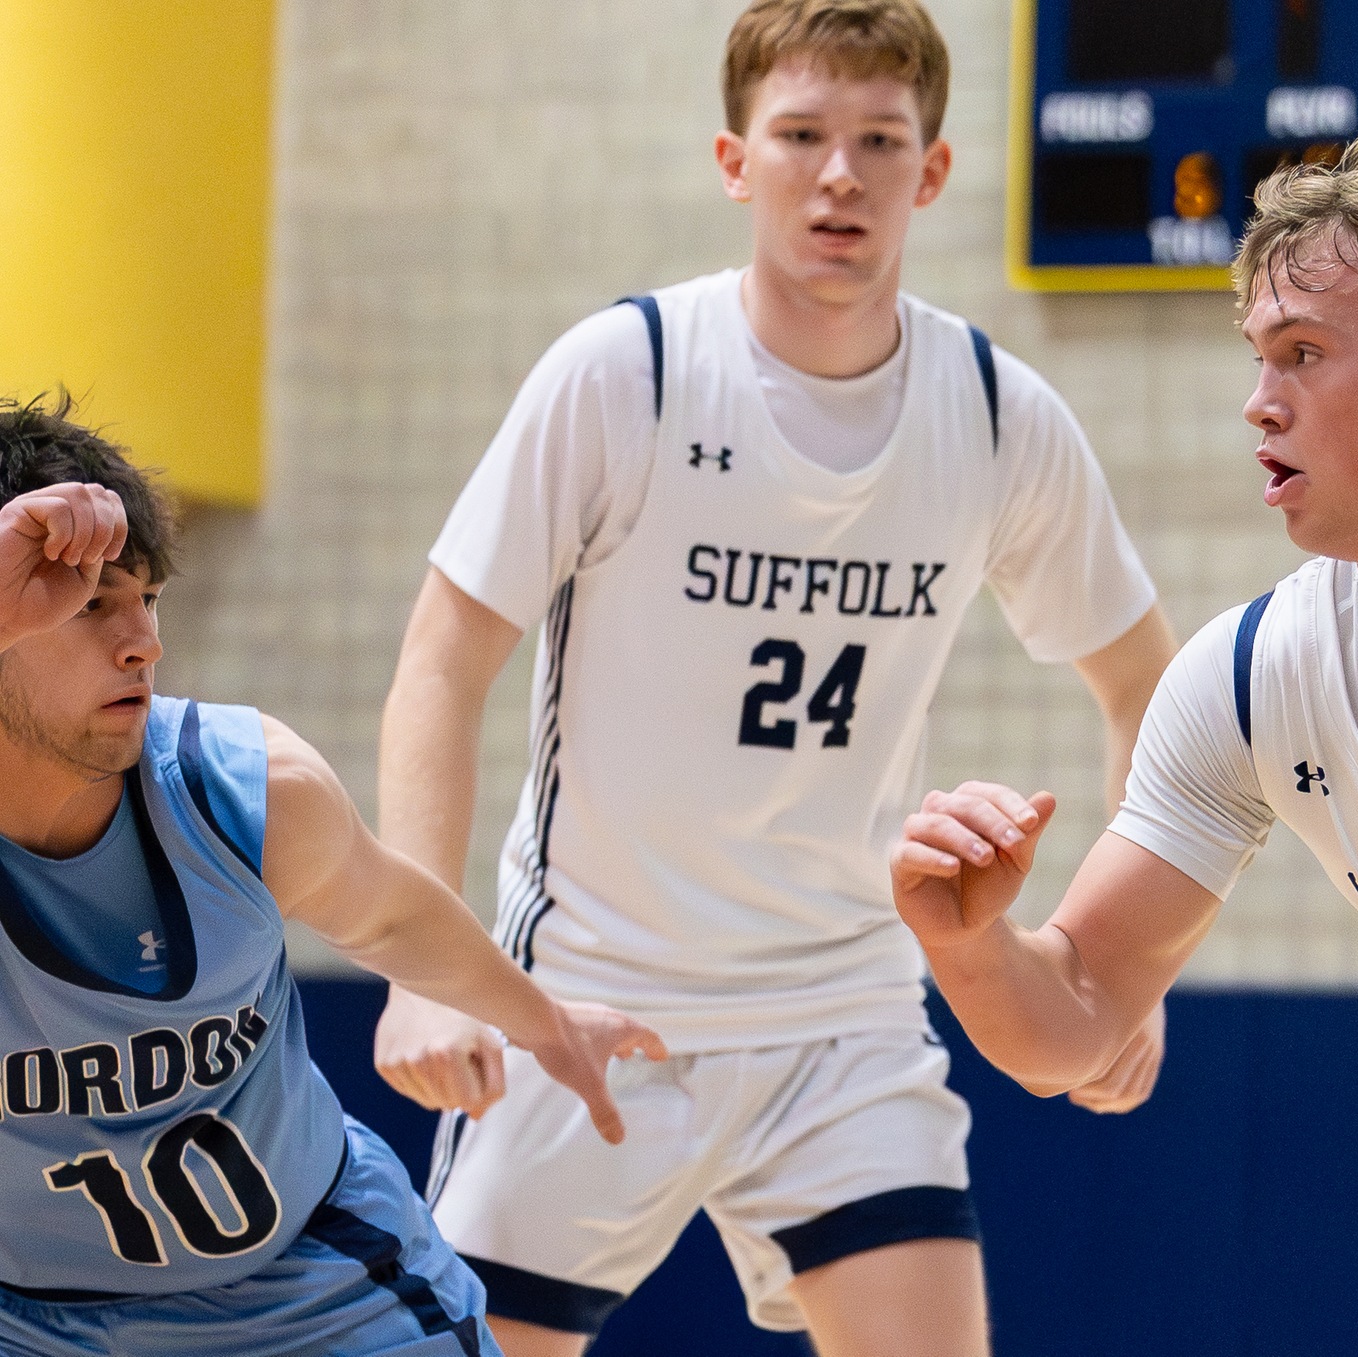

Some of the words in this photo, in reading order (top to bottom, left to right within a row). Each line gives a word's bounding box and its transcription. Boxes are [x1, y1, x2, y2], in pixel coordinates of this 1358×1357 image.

[684, 544, 947, 618] SUFFOLK
[738, 638, 867, 751] 24
[0, 998, 268, 1121] ORDON
[42, 1112, 282, 1266] 10
